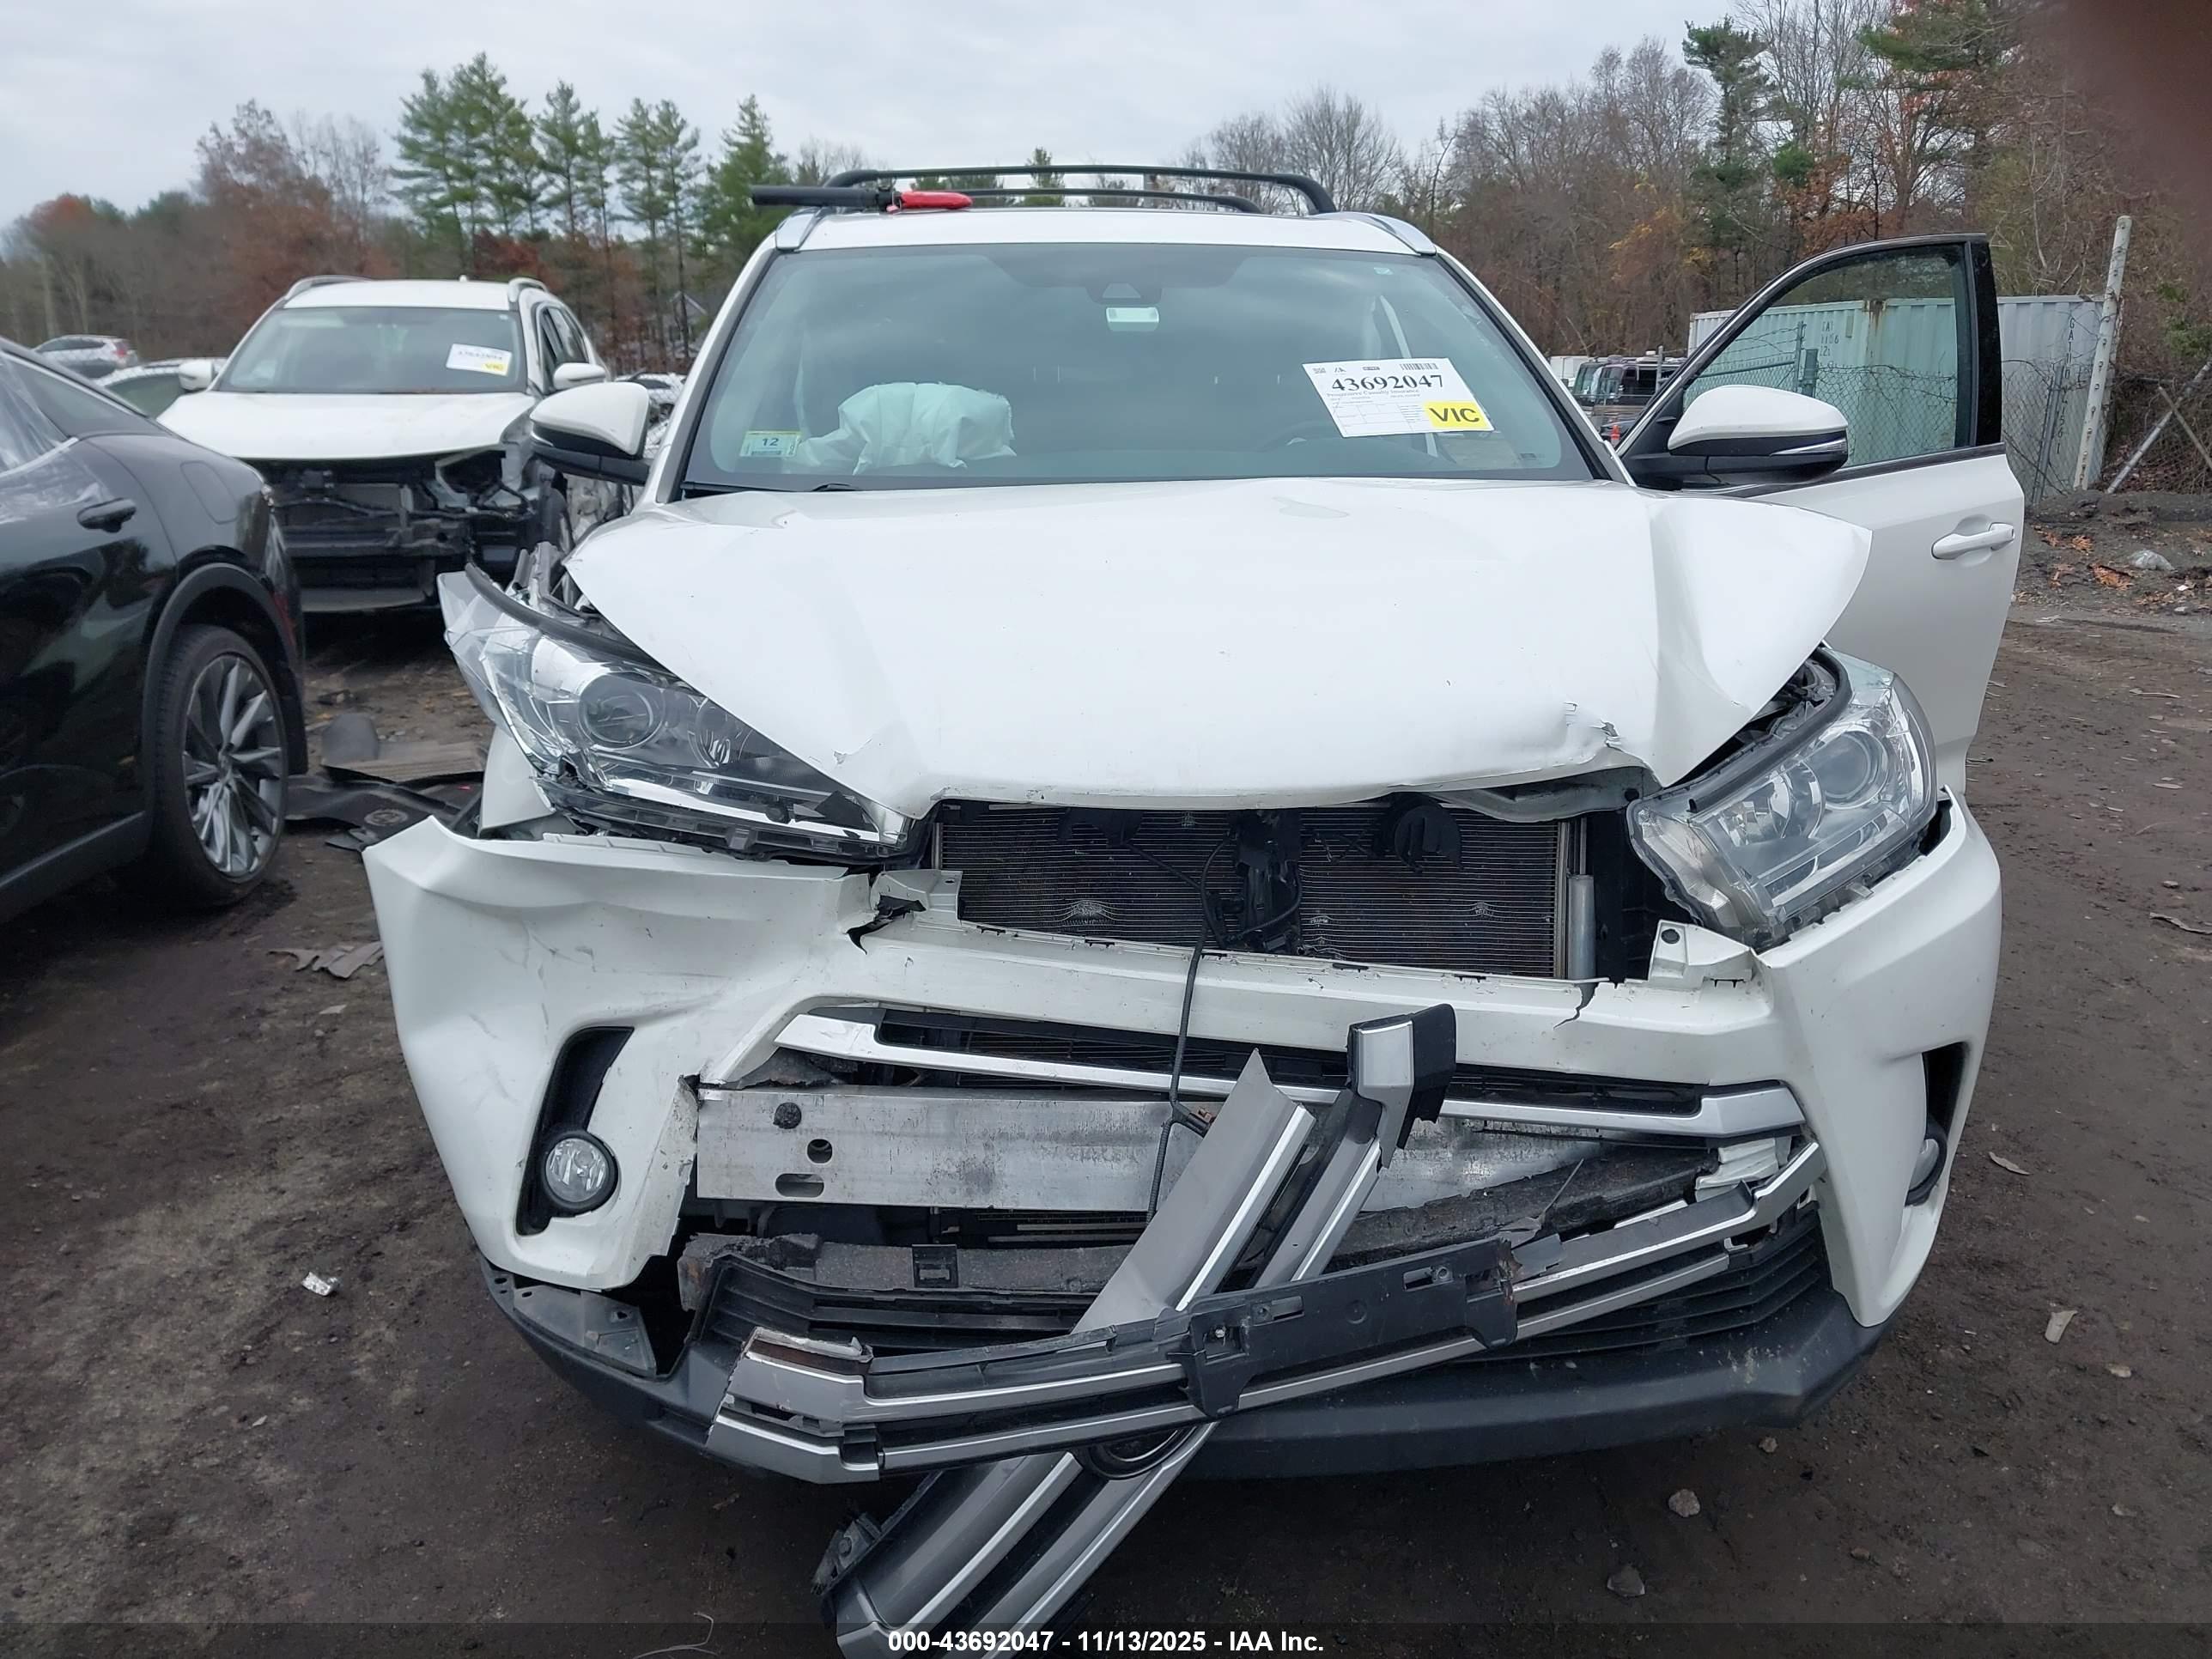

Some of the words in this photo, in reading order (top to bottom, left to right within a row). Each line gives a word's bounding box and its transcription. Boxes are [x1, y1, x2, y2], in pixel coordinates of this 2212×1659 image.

[1332, 374, 1443, 392] 43692047
[1428, 408, 1480, 422] VIC
[763, 437, 779, 447] 12
